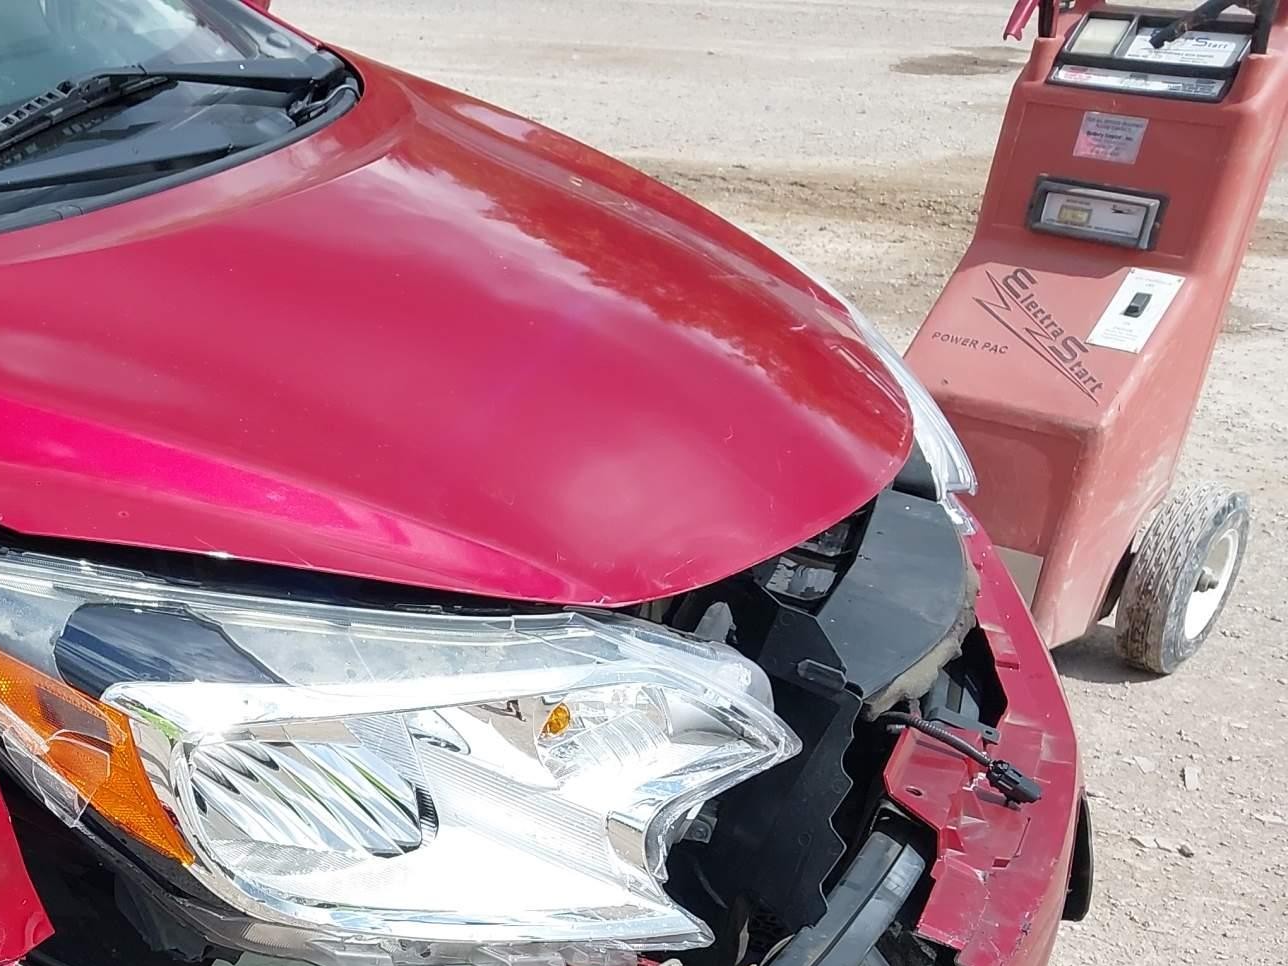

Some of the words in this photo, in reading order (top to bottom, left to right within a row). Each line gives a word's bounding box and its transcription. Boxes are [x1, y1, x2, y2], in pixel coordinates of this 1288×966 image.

[1002, 268, 1064, 338] Electra
[932, 331, 979, 348] POWER
[981, 341, 1009, 355] PAC
[1048, 335, 1104, 393] Start
